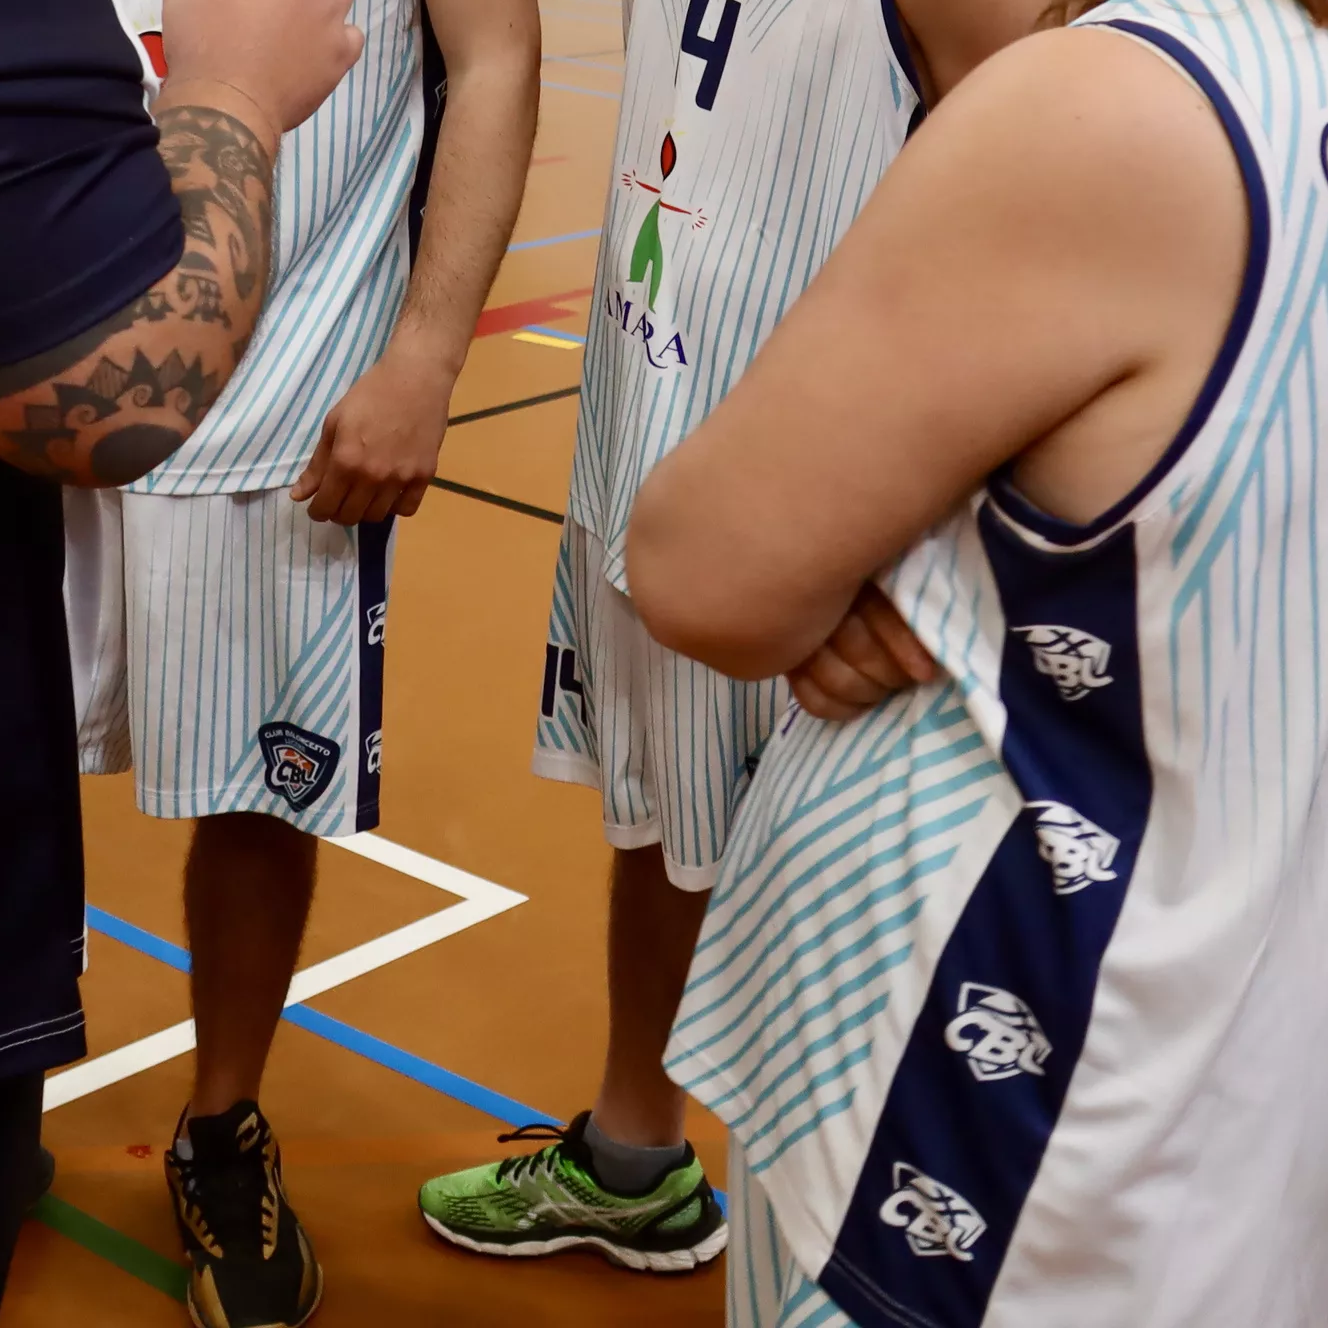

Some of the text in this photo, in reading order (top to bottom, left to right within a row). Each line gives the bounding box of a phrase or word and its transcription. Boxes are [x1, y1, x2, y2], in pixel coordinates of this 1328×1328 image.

[274, 760, 314, 786] CBL
[944, 1008, 1045, 1076] CBL
[880, 1187, 974, 1261] CBL
